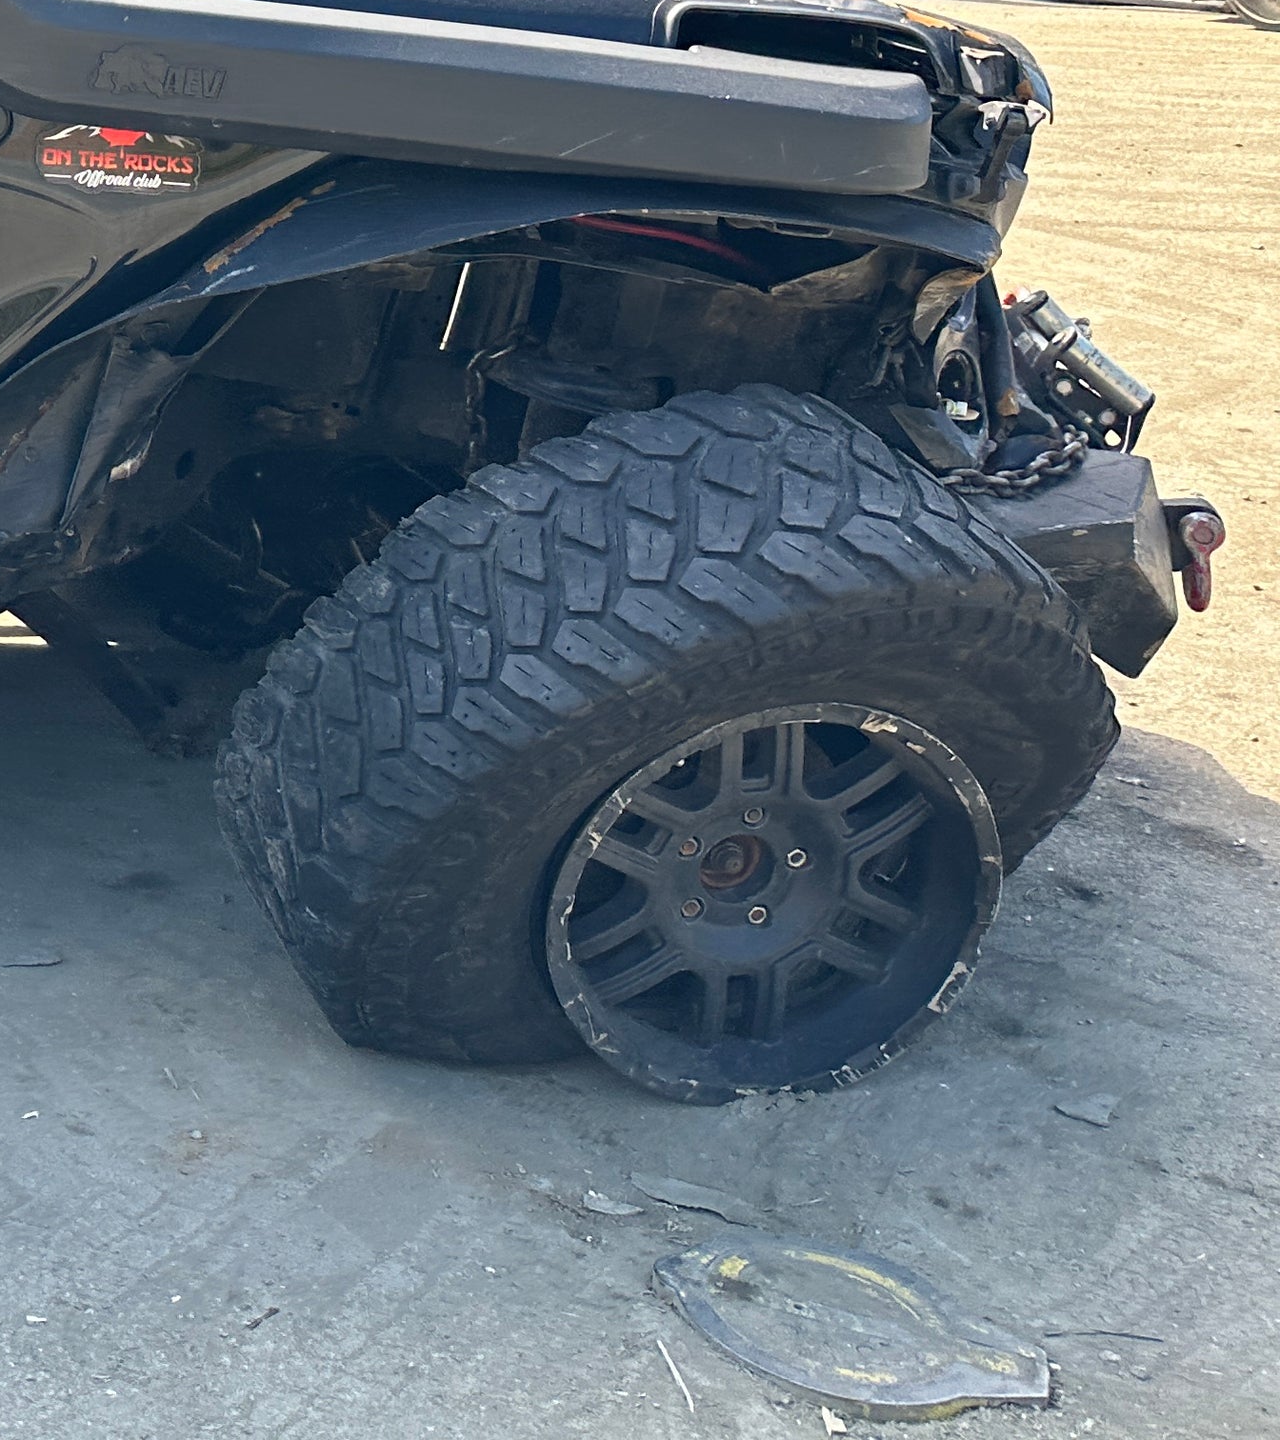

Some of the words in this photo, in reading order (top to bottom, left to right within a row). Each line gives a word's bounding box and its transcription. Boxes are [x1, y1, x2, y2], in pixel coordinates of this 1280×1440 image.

[162, 66, 227, 99] AEV
[42, 148, 72, 166] ON
[78, 150, 118, 170] THE
[124, 153, 194, 175] ROCKS
[73, 169, 132, 188] Offroad
[133, 171, 162, 189] club
